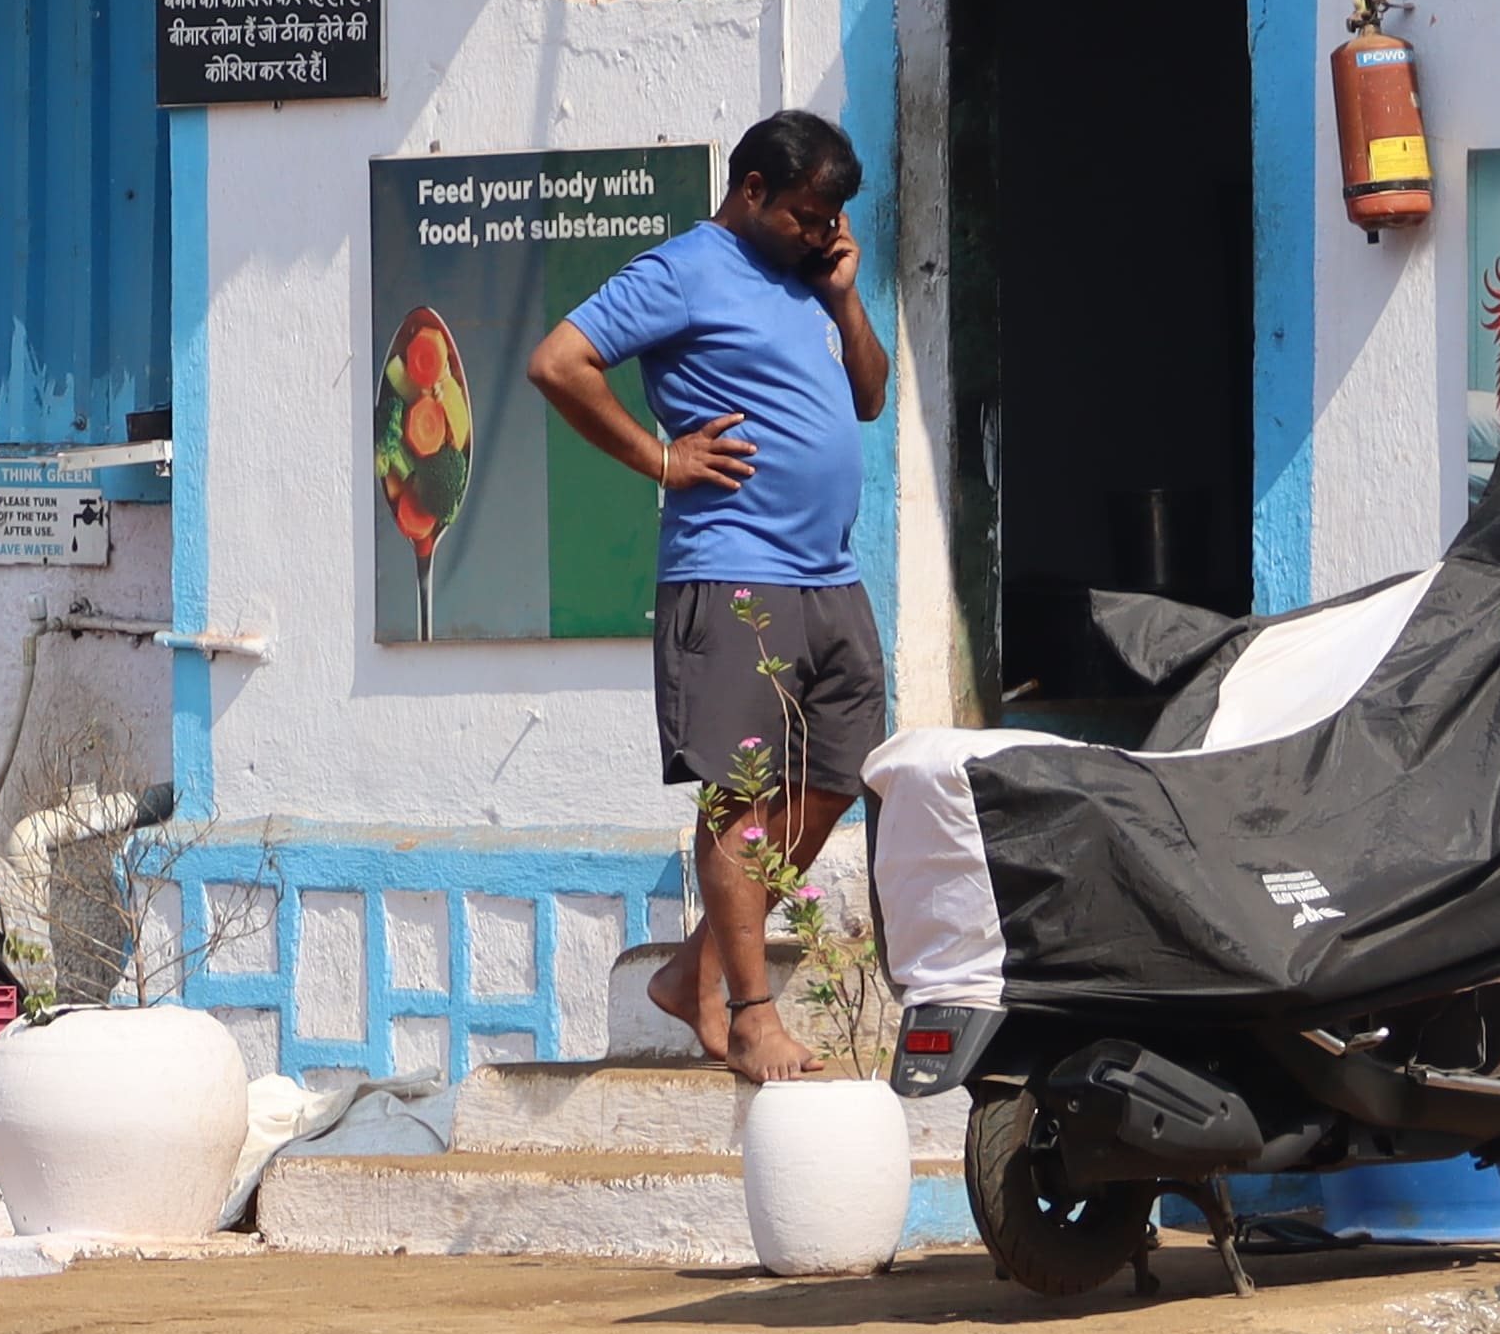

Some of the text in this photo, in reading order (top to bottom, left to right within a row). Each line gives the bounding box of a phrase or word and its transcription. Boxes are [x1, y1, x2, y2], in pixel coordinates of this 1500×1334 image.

[418, 169, 654, 209] Feed your body with
[418, 213, 665, 247] food, not substances
[2, 467, 92, 483] THINK GREEN
[33, 497, 57, 507] TURN
[16, 511, 34, 522] THE
[36, 511, 58, 522] TAPS
[4, 526, 55, 537] AFTER USE.
[25, 543, 64, 556] WATER!
